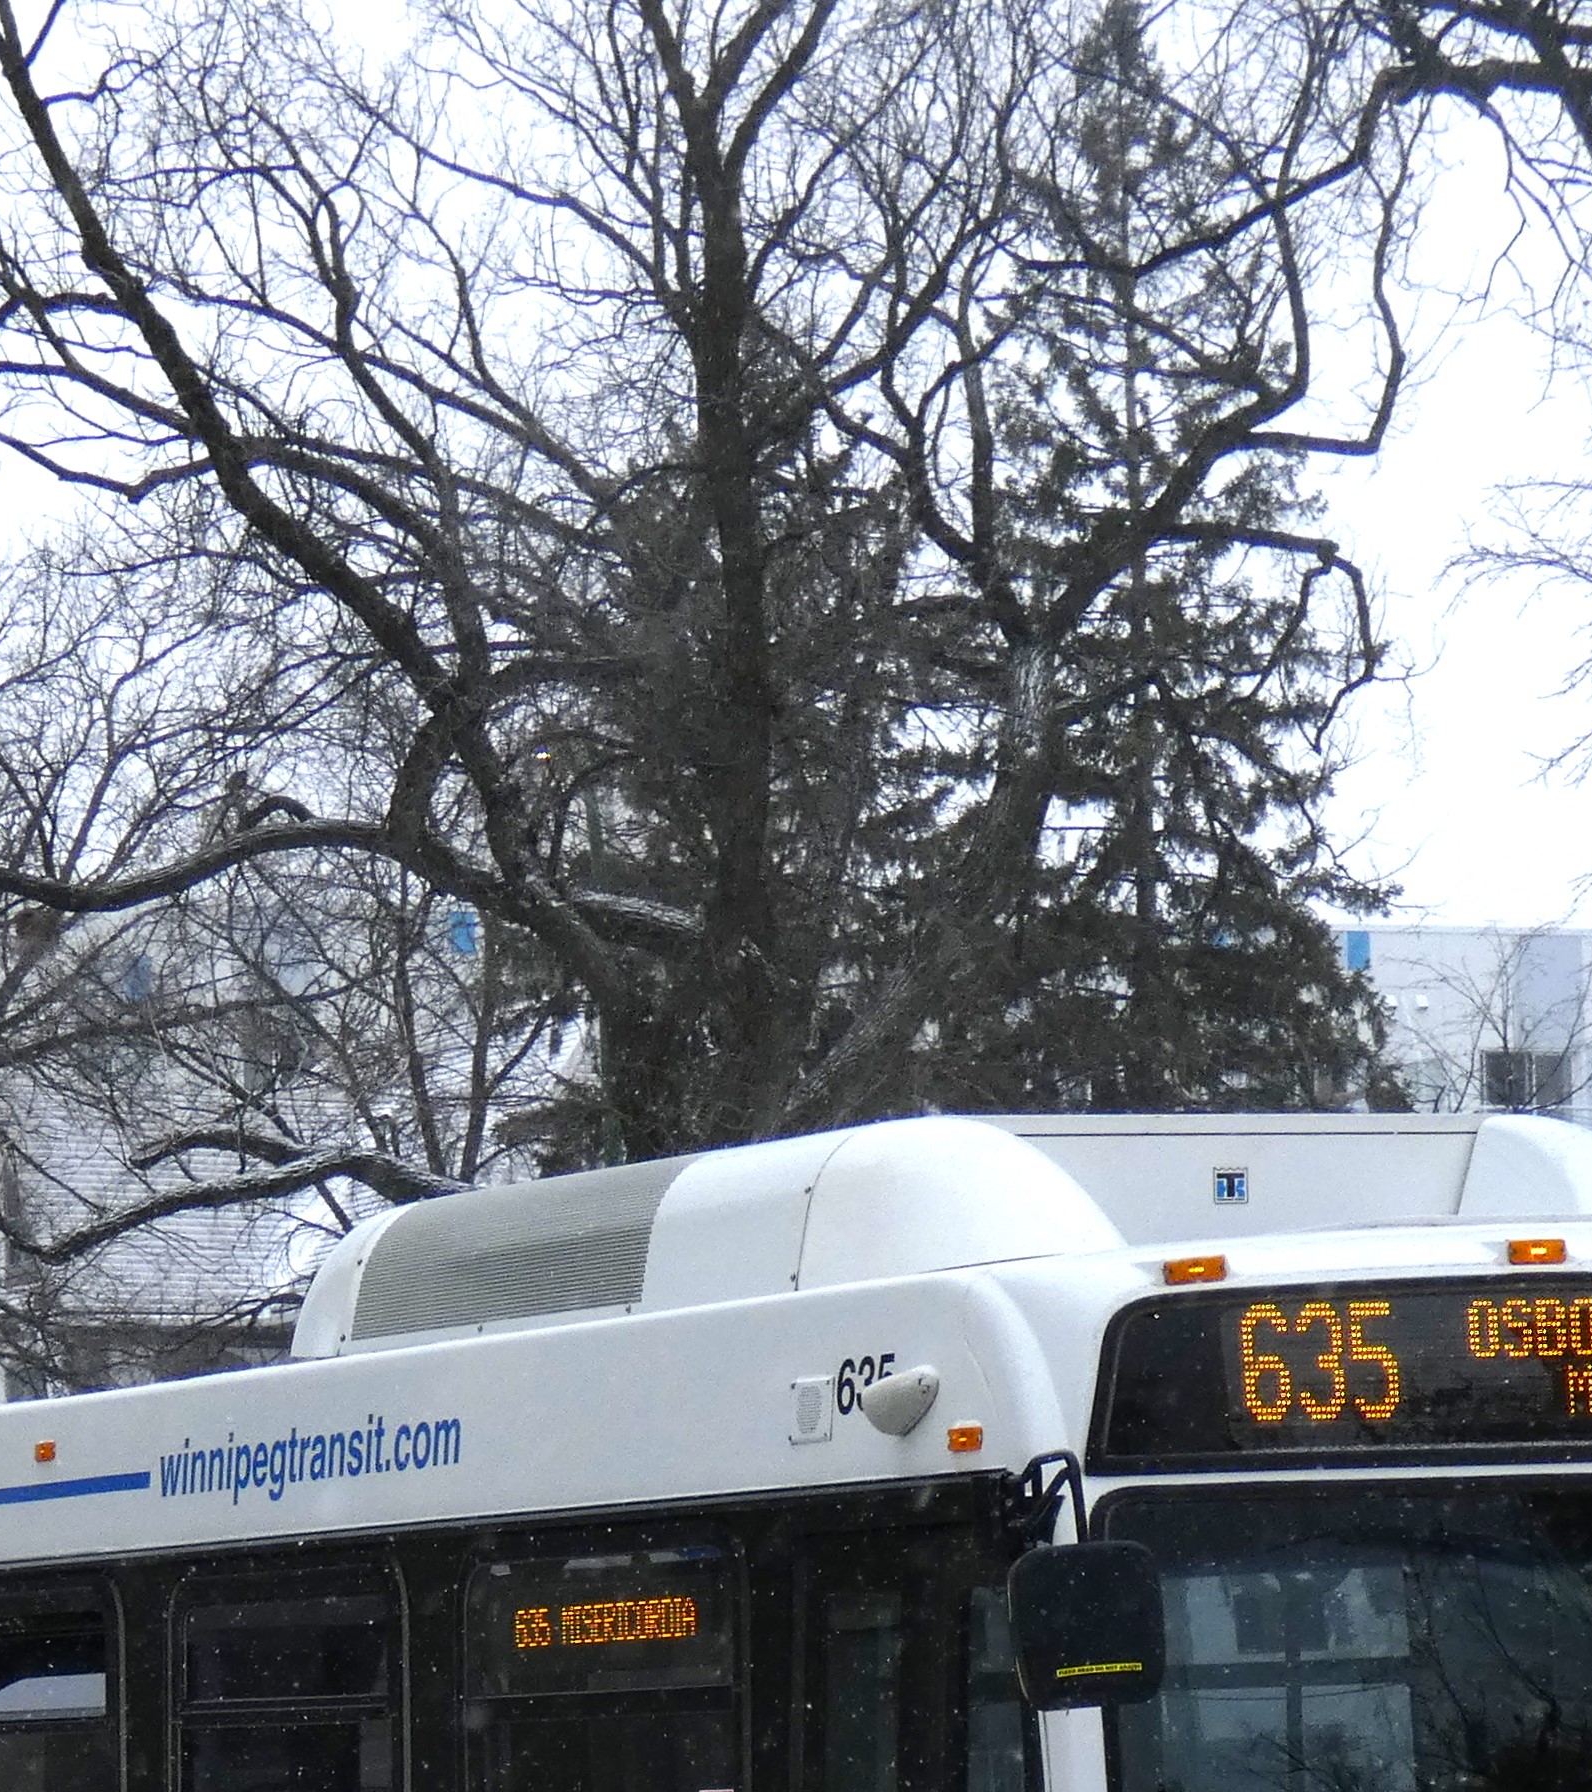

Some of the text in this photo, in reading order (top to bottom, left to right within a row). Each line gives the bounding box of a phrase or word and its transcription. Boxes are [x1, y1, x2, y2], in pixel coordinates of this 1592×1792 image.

[1240, 1302, 1400, 1422] 635
[160, 1413, 461, 1505] winnipegtransit.com
[515, 1596, 697, 1649] 635 MISERICORDIA
